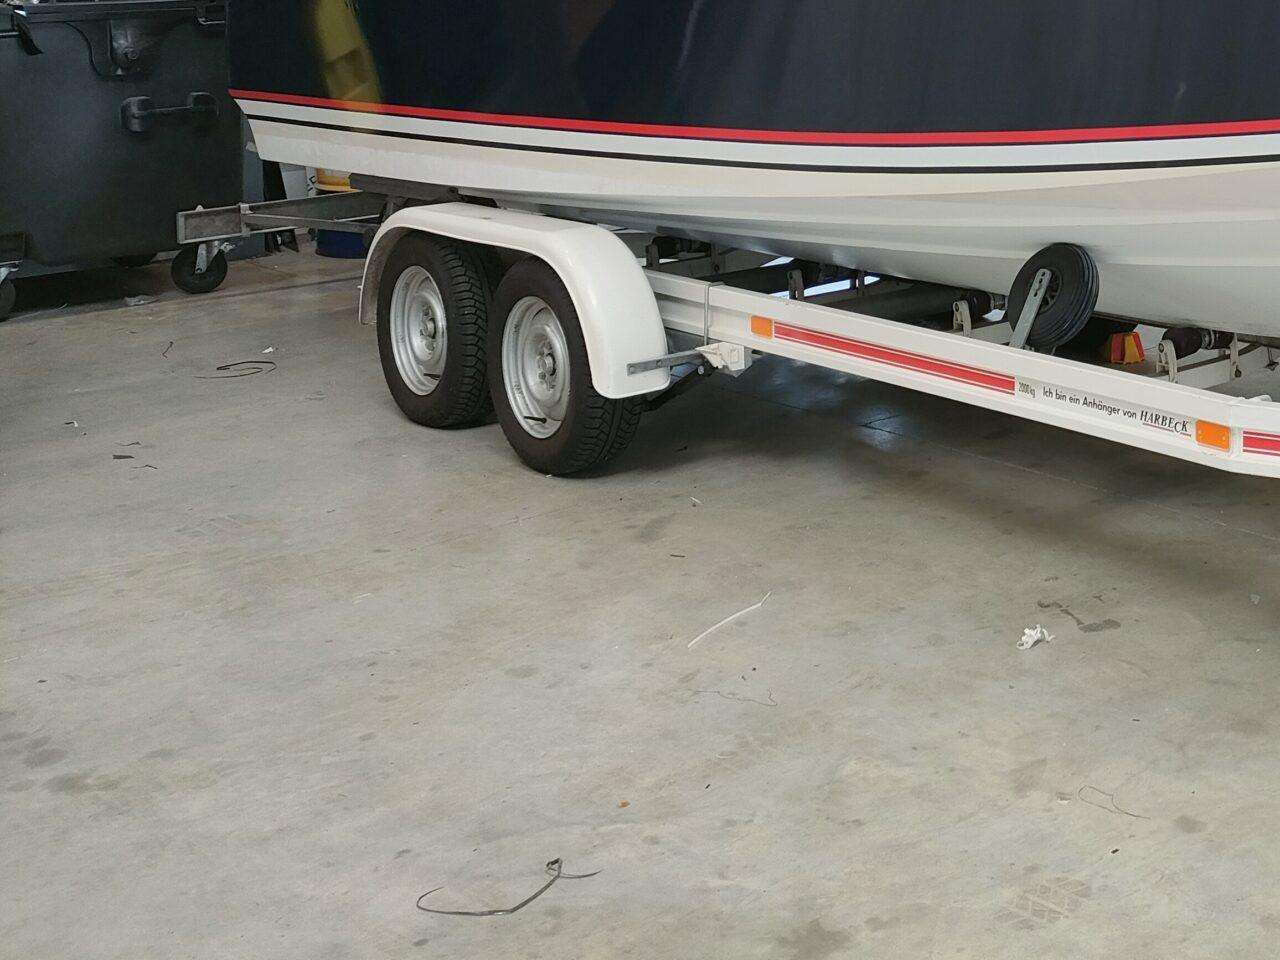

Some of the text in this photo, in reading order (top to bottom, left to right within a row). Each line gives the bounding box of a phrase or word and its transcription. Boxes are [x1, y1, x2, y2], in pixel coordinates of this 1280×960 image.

[1043, 387, 1189, 434] Ich bin ein Anhänger von HARBECK
